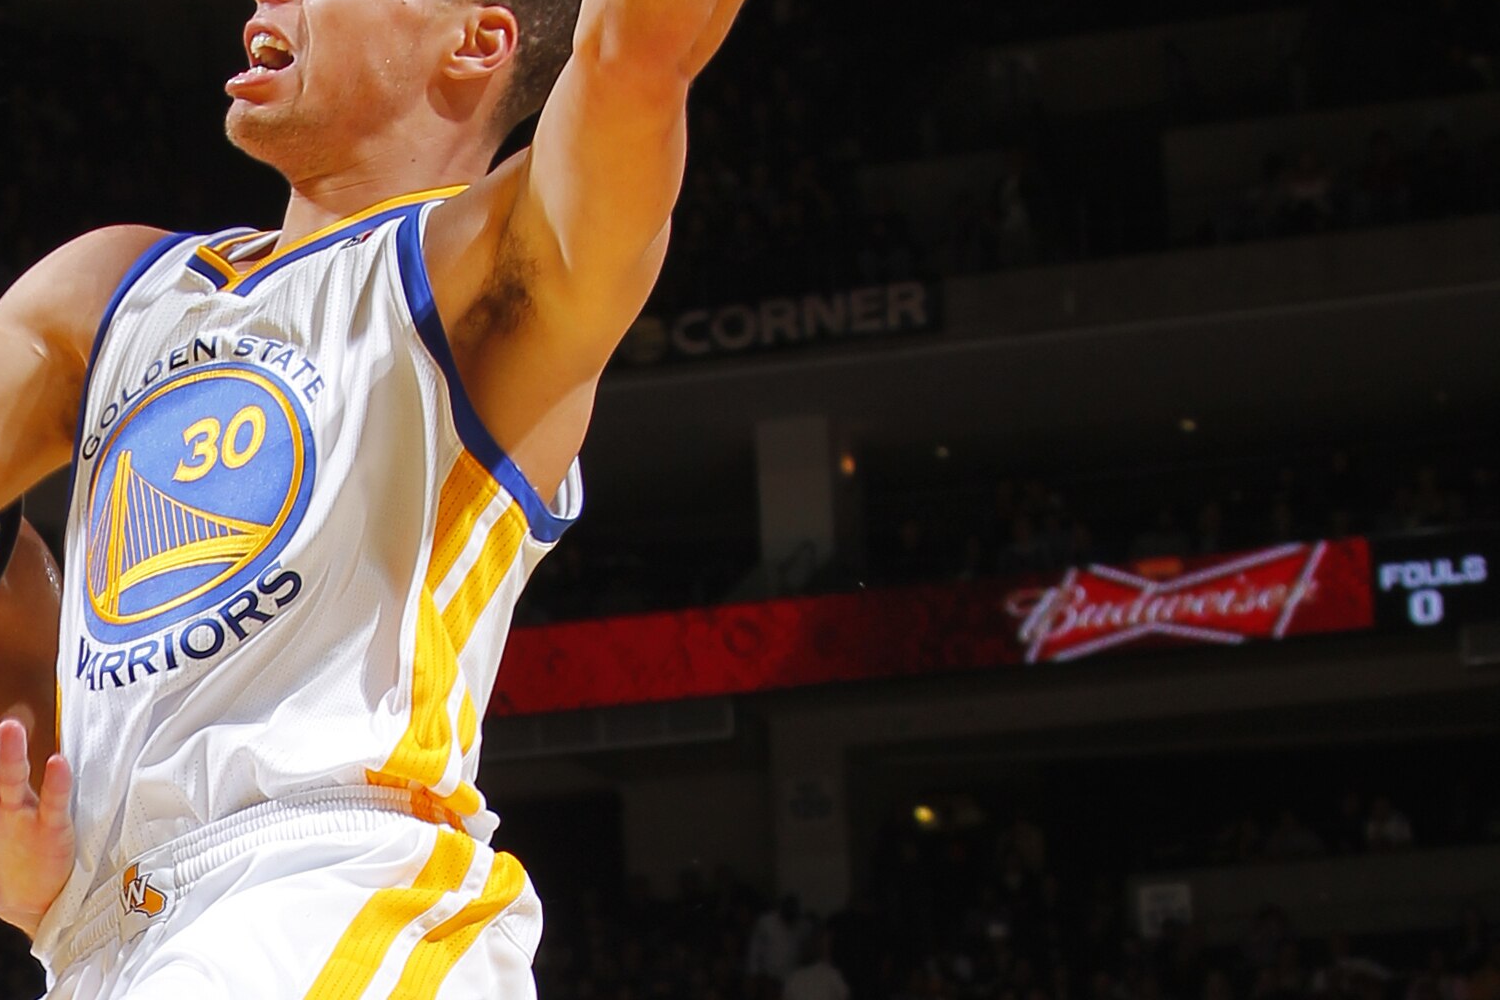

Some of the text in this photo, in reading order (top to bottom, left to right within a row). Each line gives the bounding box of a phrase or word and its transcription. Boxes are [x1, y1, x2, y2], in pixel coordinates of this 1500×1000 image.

[671, 280, 929, 356] CORNER
[82, 336, 326, 461] GOLDEN STATE
[172, 404, 267, 481] 30
[1379, 553, 1488, 592] FOULS
[1408, 588, 1445, 627] 0
